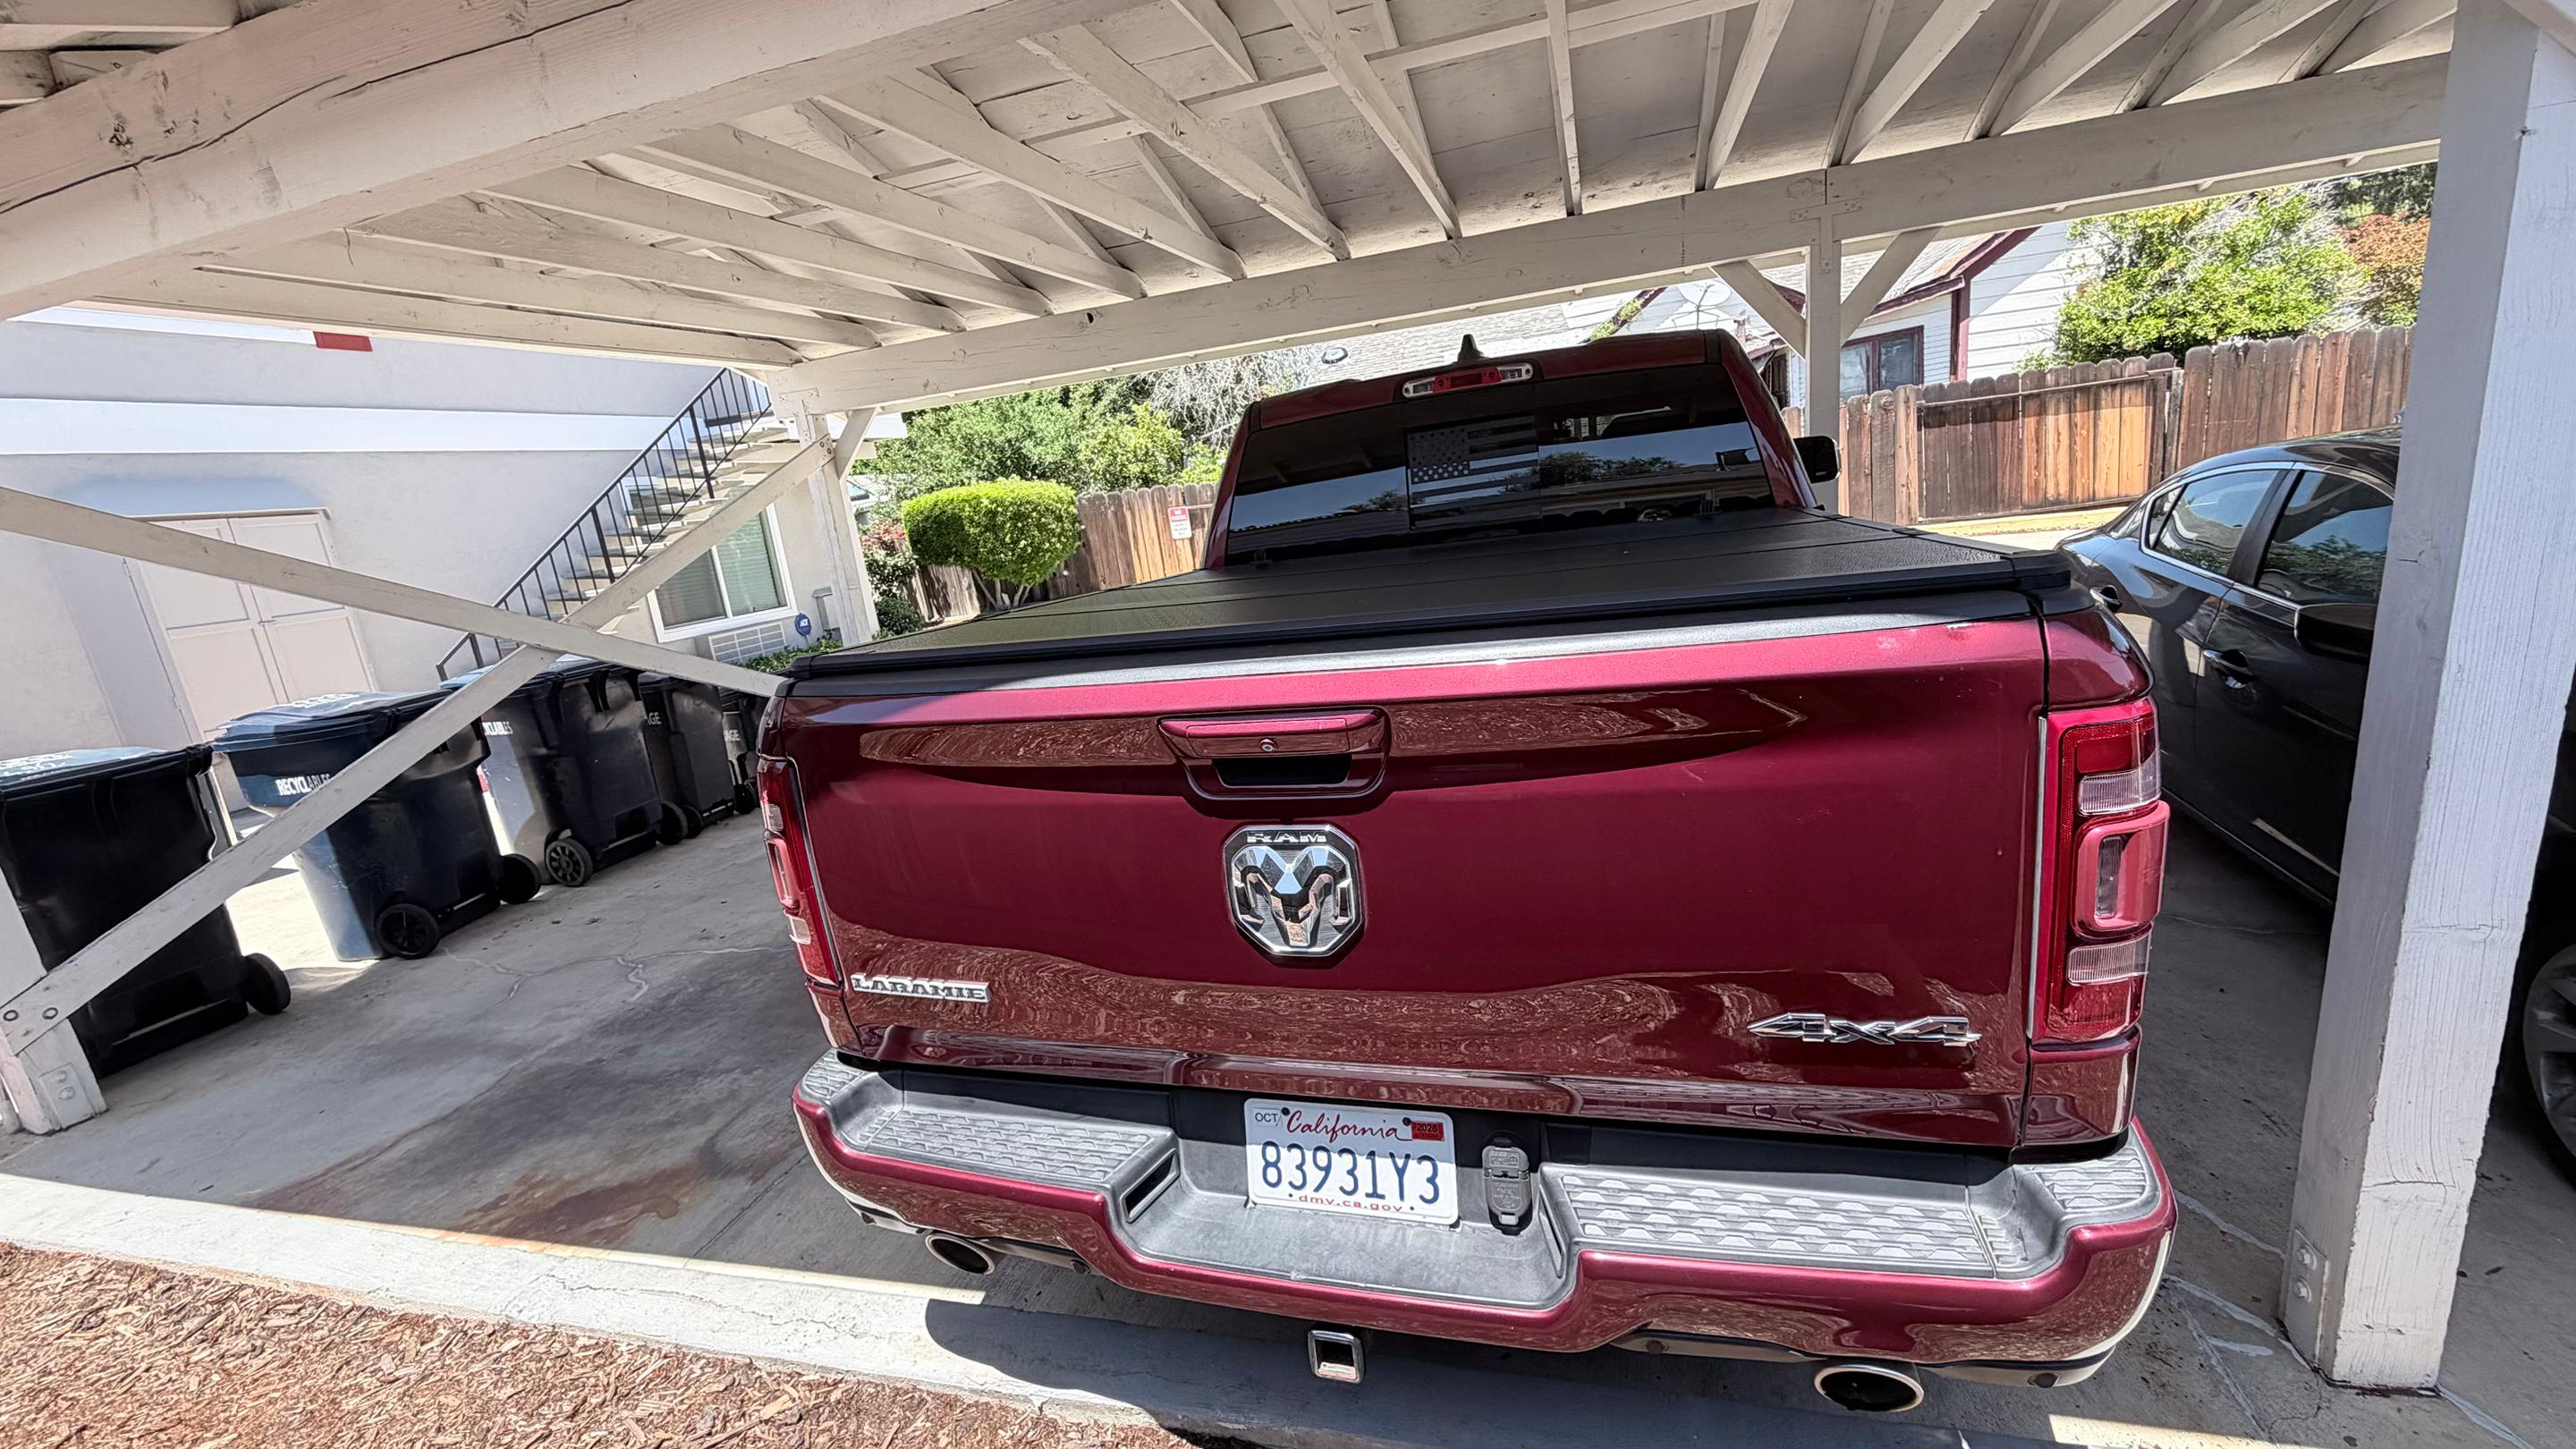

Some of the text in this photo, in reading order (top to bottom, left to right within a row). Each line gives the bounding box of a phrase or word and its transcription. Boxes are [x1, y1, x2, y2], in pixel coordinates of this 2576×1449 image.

[1246, 831, 1327, 843] RAM
[851, 973, 992, 1003] LARAMIE
[1255, 1112, 1278, 1123] OCT
[1287, 1110, 1413, 1144] California
[1261, 1140, 1440, 1204] 83931Y3
[1299, 1194, 1403, 1213] dmv.ca.gov
